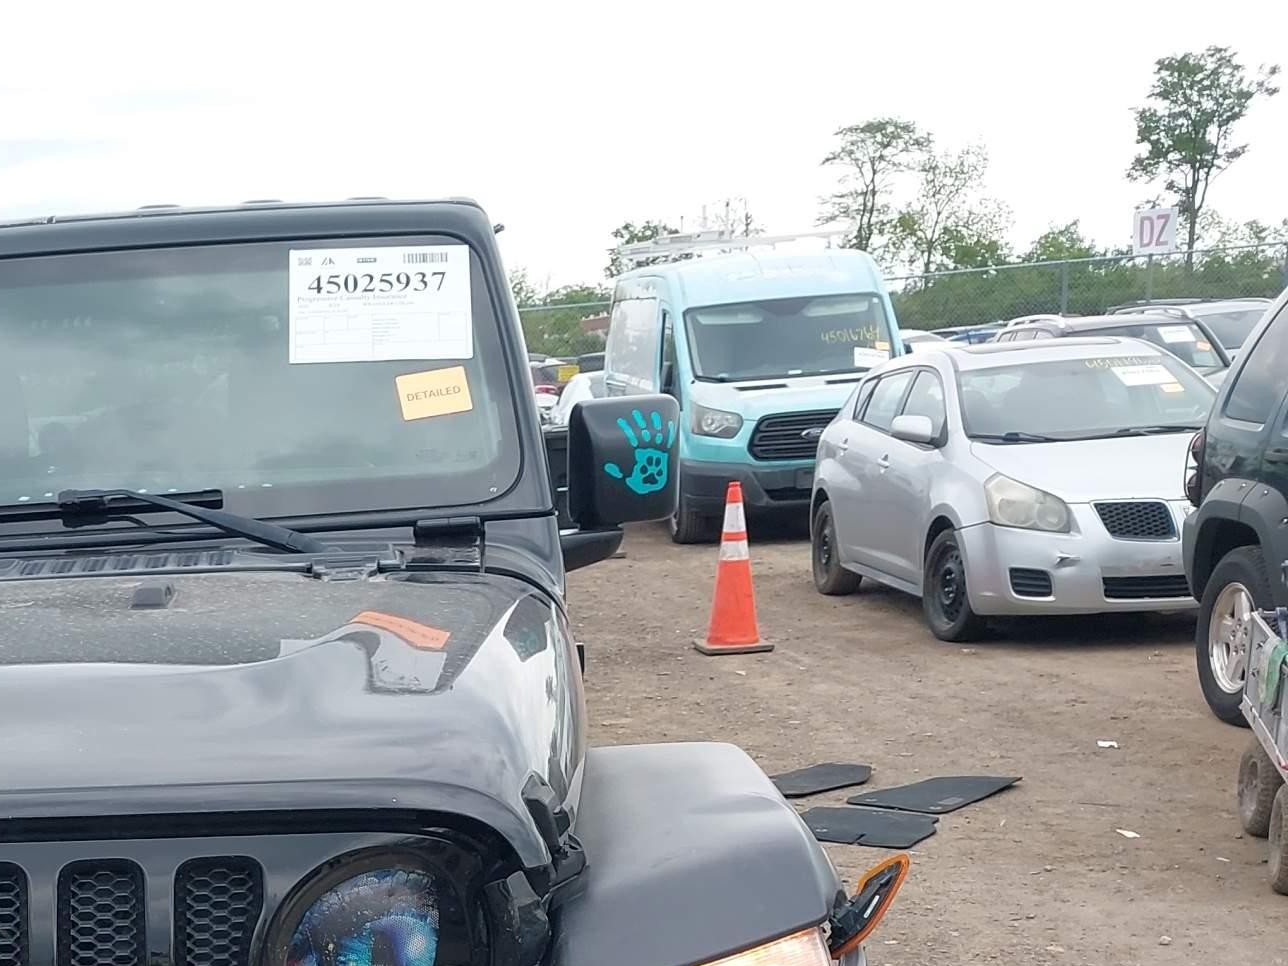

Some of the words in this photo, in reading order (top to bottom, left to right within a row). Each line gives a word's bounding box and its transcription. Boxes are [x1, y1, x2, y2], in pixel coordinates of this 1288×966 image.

[1139, 213, 1171, 248] DZ
[308, 272, 447, 295] 45025937
[407, 385, 461, 401] DETAILED
